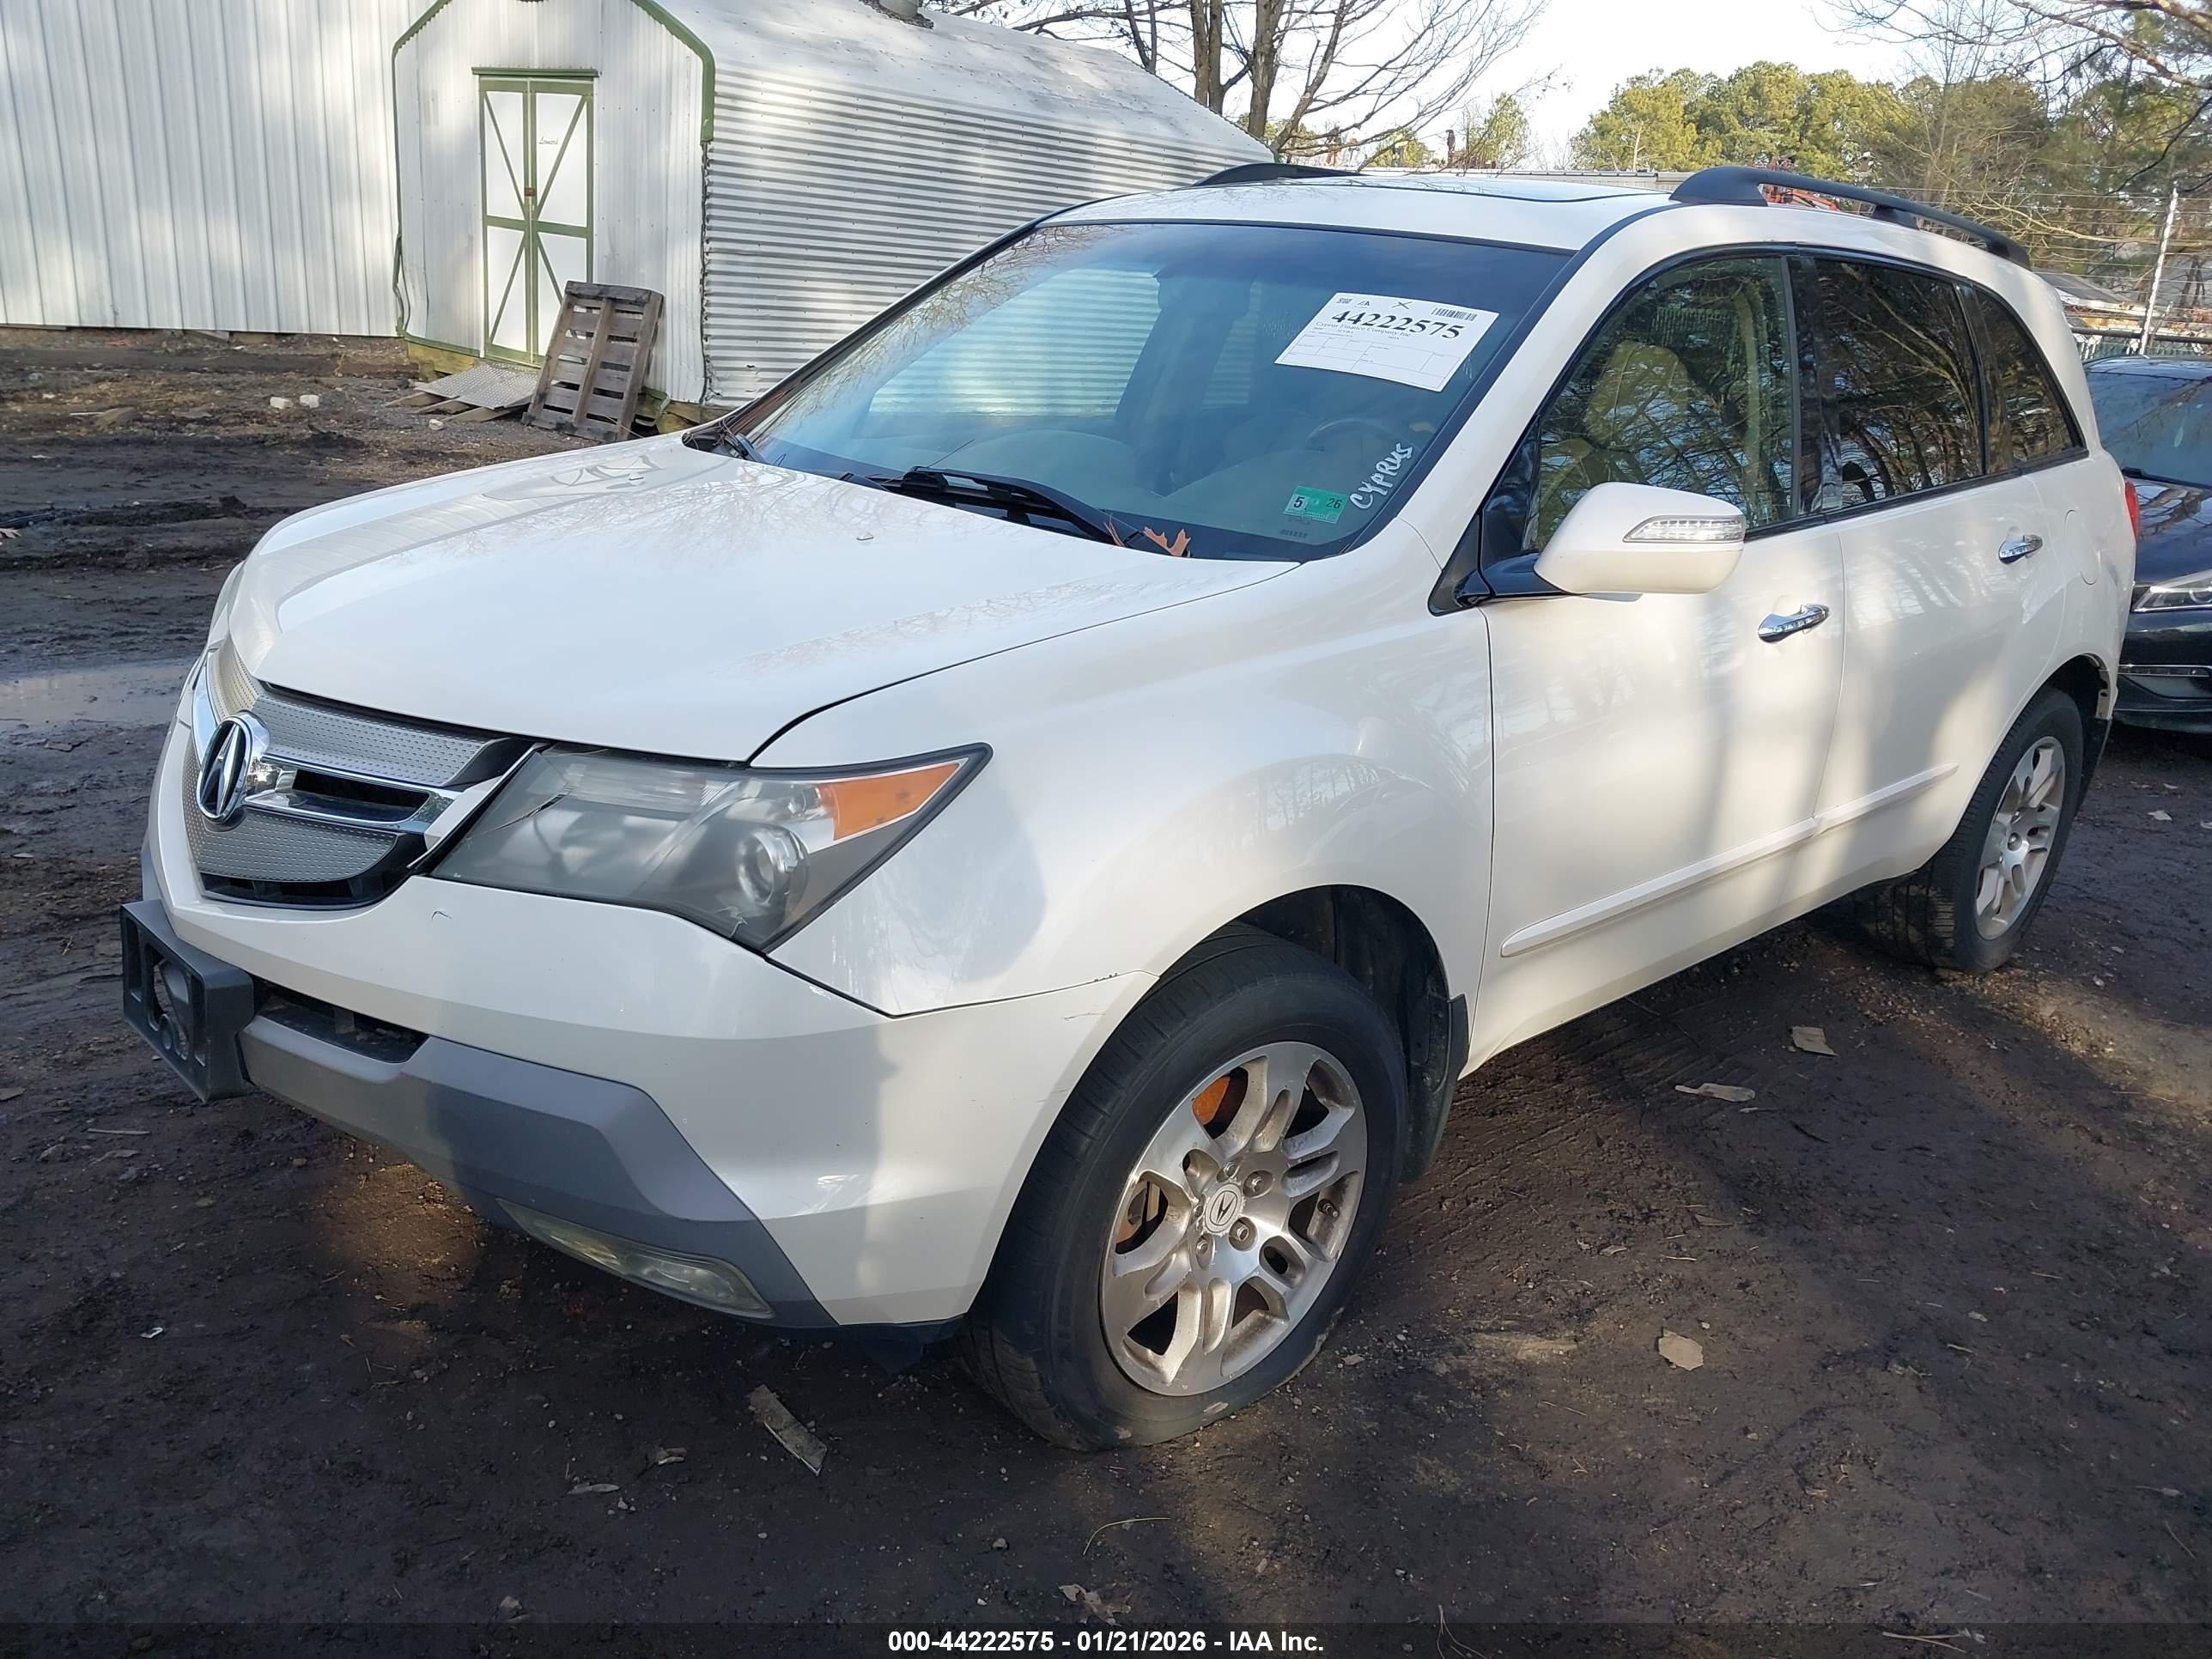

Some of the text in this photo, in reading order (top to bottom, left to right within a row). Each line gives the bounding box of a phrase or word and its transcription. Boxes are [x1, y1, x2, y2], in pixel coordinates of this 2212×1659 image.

[1331, 310, 1465, 338] 44222575
[1349, 442, 1413, 509] CYPRUS
[1293, 496, 1343, 509] 5 26
